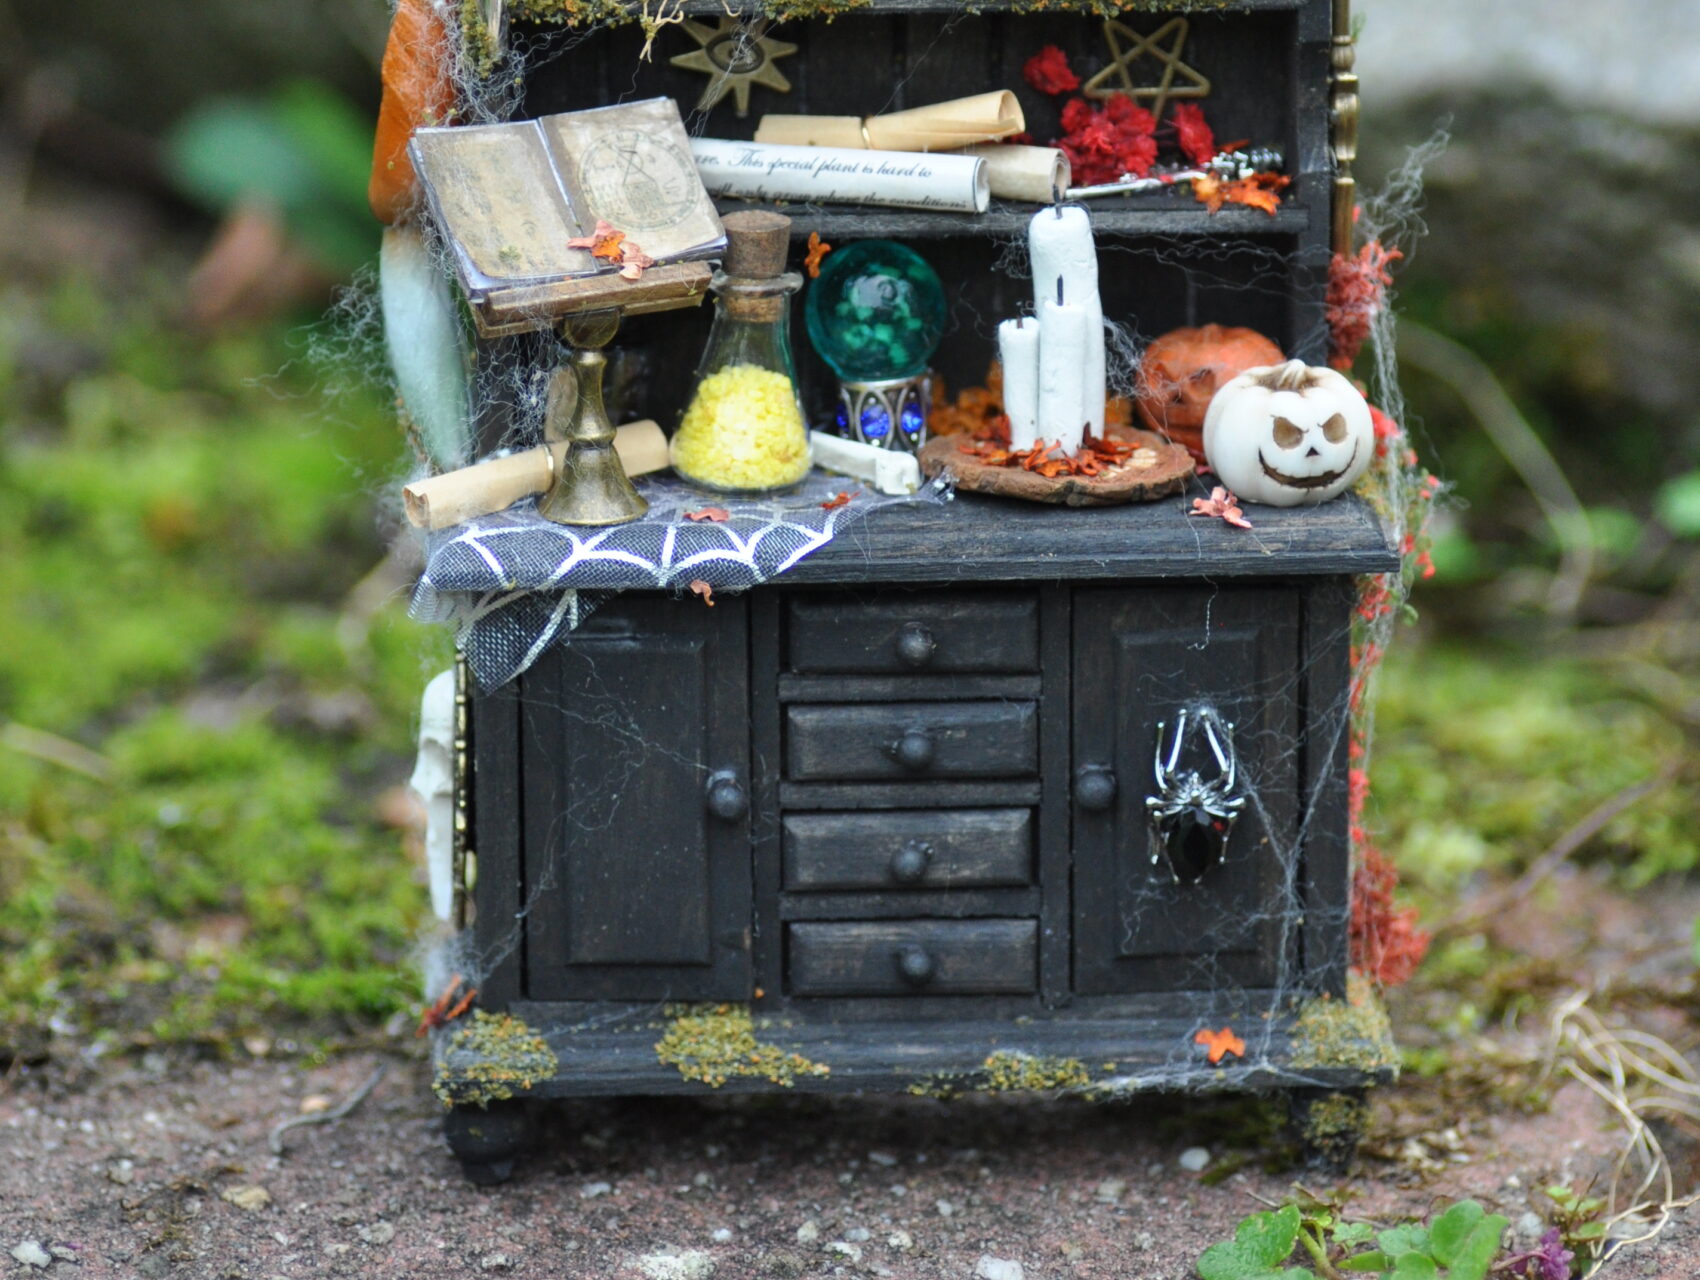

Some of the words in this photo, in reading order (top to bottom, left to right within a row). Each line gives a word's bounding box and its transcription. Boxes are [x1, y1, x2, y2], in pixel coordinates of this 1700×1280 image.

[727, 147, 764, 167] This
[766, 156, 820, 176] special
[812, 157, 860, 178] plant
[876, 160, 920, 176] hard
[917, 165, 932, 178] to
[863, 191, 885, 204] the
[888, 195, 967, 209] conditions
